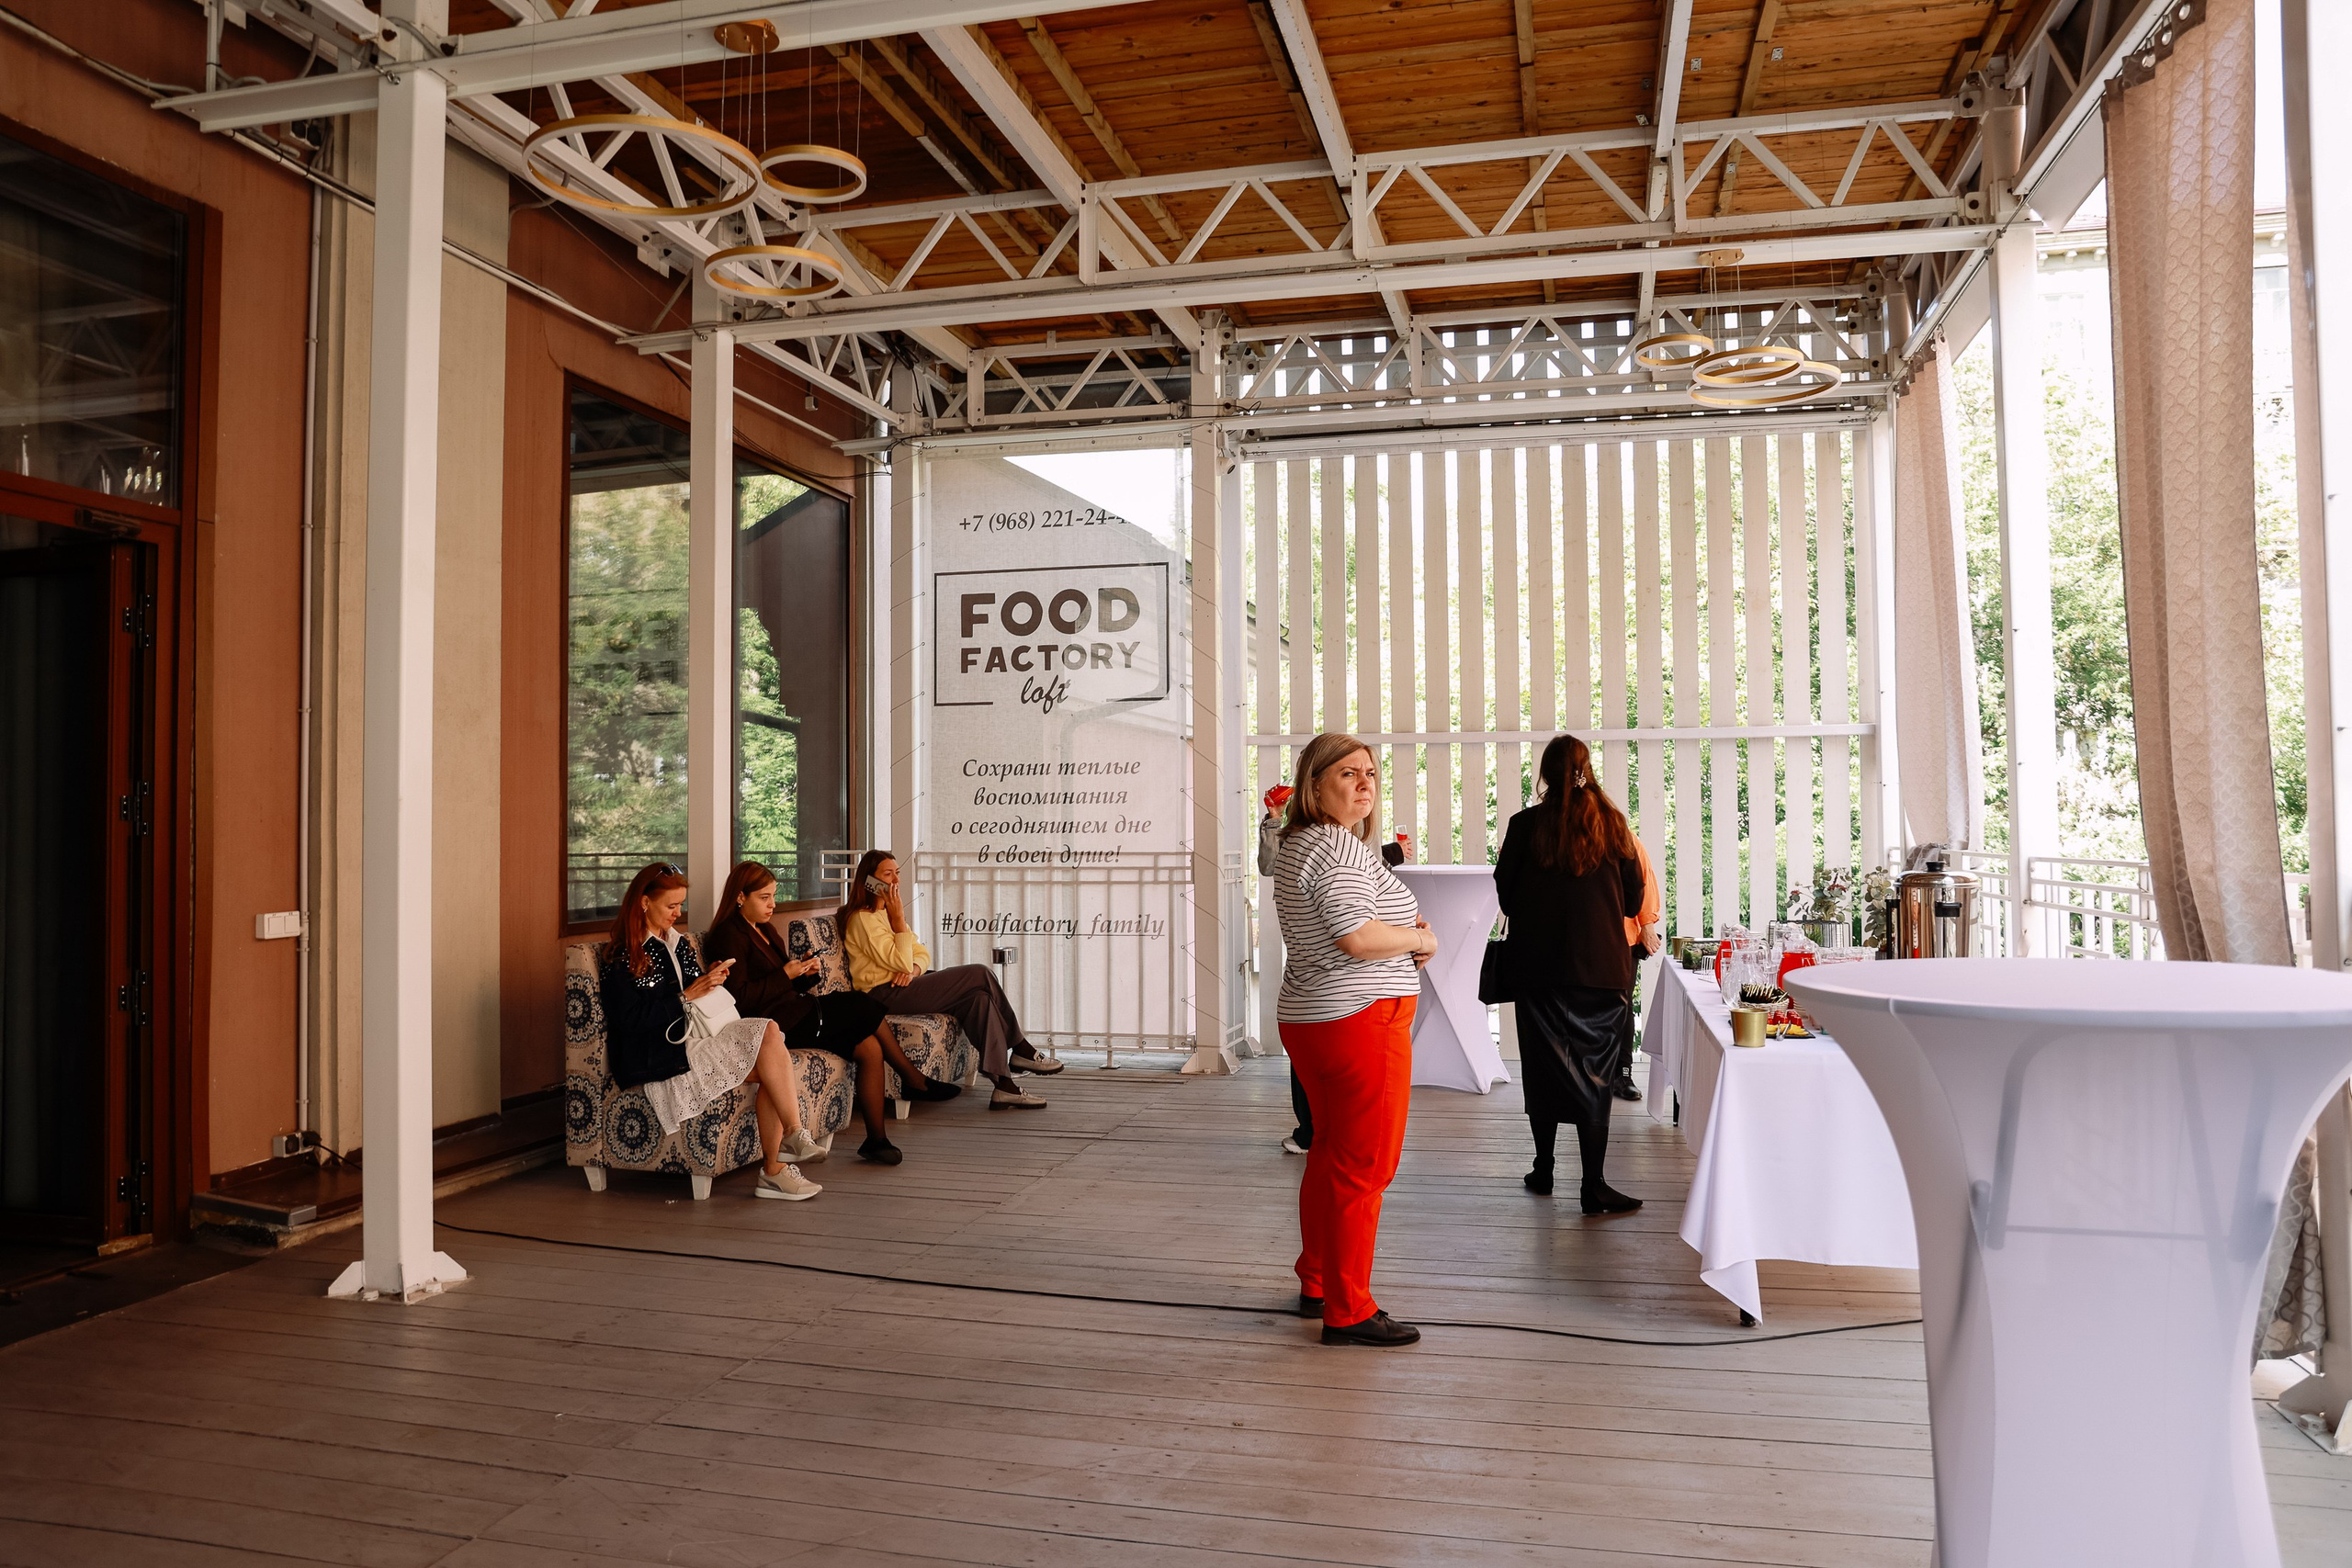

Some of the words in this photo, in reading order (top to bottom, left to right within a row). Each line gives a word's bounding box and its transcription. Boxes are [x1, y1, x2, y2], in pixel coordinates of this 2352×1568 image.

[959, 514, 984, 532] +7
[989, 511, 1035, 534] (968)
[1041, 508, 1131, 528] 221-24-
[960, 587, 1140, 638] FOOD
[960, 641, 1141, 674] FACTORY
[1021, 674, 1071, 715] loft
[963, 759, 1051, 783] Сохрани
[1057, 761, 1141, 776] теплые
[974, 787, 1128, 806] воспоминания
[951, 820, 963, 834] о
[969, 815, 1108, 835] сегодняшнем
[1114, 815, 1152, 834] дне
[978, 843, 989, 863] в
[995, 843, 1053, 863] своей
[1059, 843, 1122, 869] душе!
